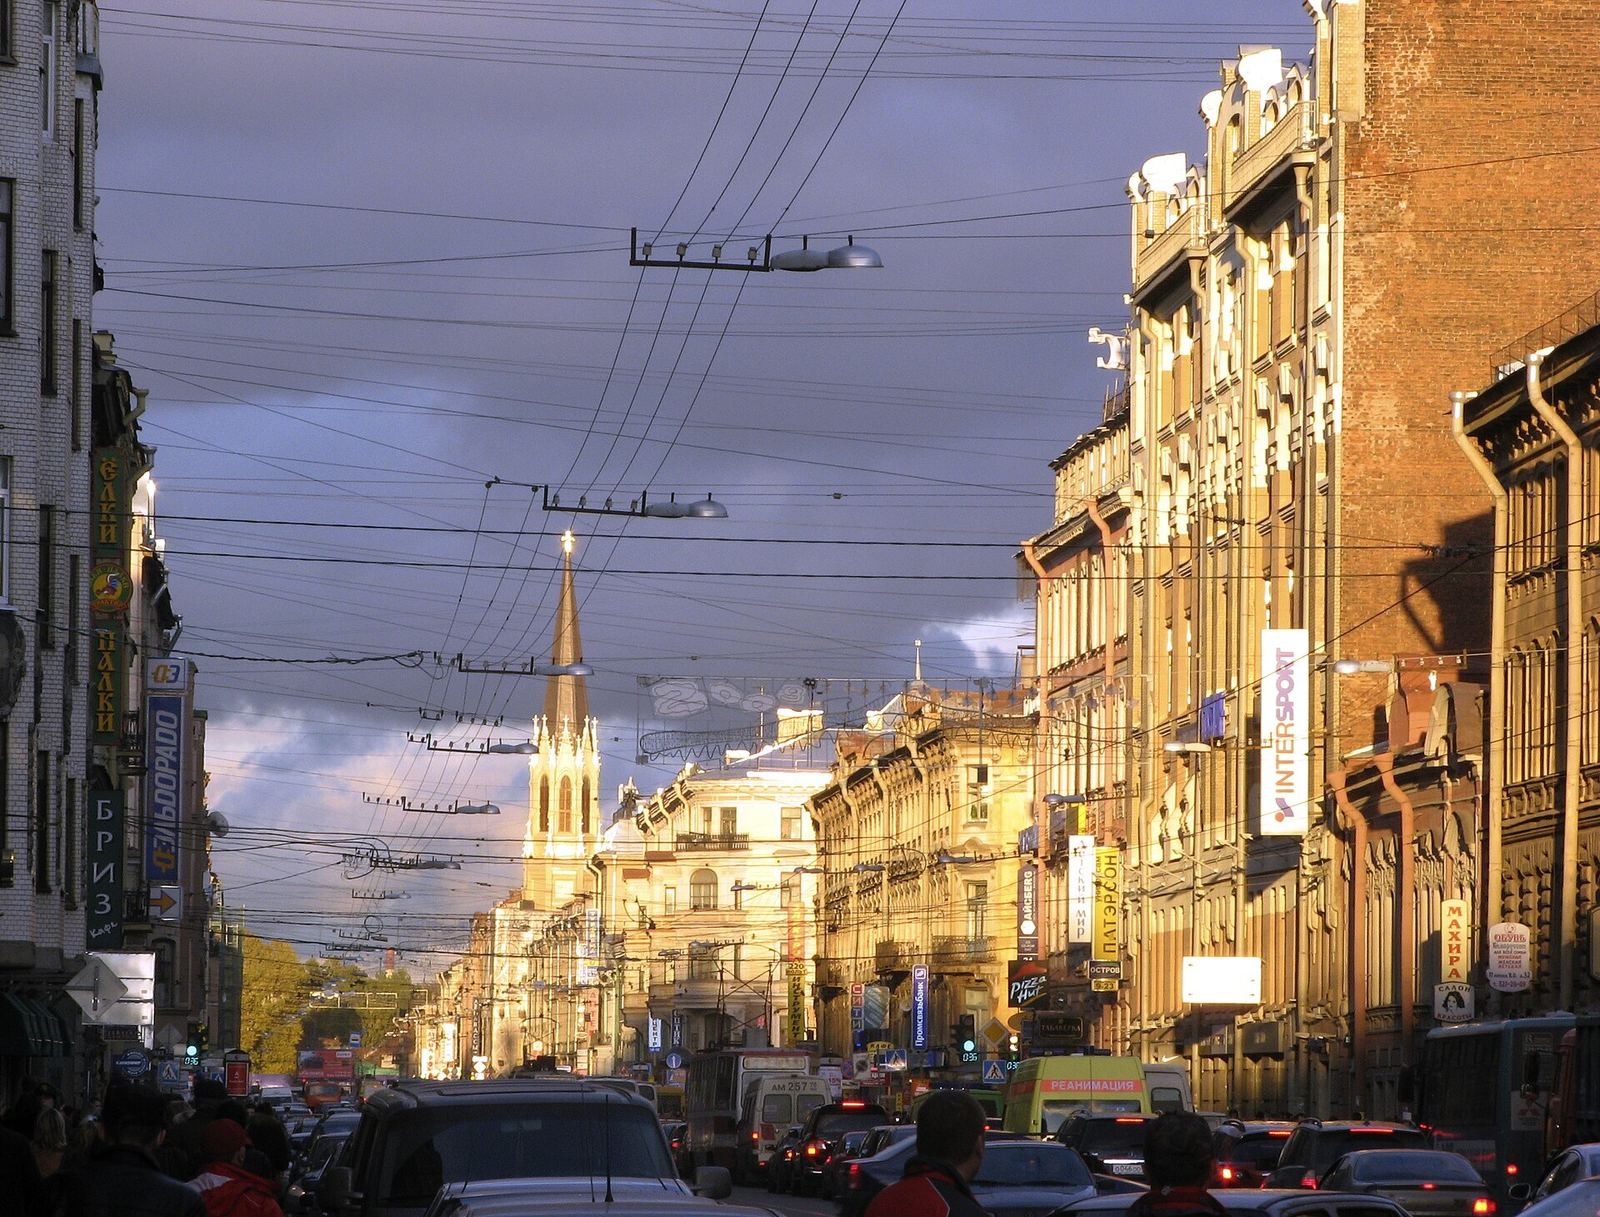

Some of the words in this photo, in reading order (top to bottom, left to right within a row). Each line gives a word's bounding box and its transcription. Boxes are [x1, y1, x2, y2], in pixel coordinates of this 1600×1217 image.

[95, 631, 117, 733] ПАЛКИ
[1275, 647, 1295, 793] INTERSPORT
[92, 799, 116, 915] БРИЗ
[1103, 855, 1117, 953] ПАТЭРСОН
[1447, 906, 1462, 979] МАХИРА
[1494, 934, 1527, 942] ОБУВЬ
[1090, 966, 1120, 974] ОСТРОВ
[1011, 975, 1048, 1000] Pizza
[1017, 985, 1044, 1004] Hut
[1438, 984, 1472, 993] САЛОН
[914, 981, 924, 1047] Промсвязьбанк
[788, 1081, 808, 1091] 257
[1051, 1080, 1135, 1091] РЕАНИМАЦИЯ
